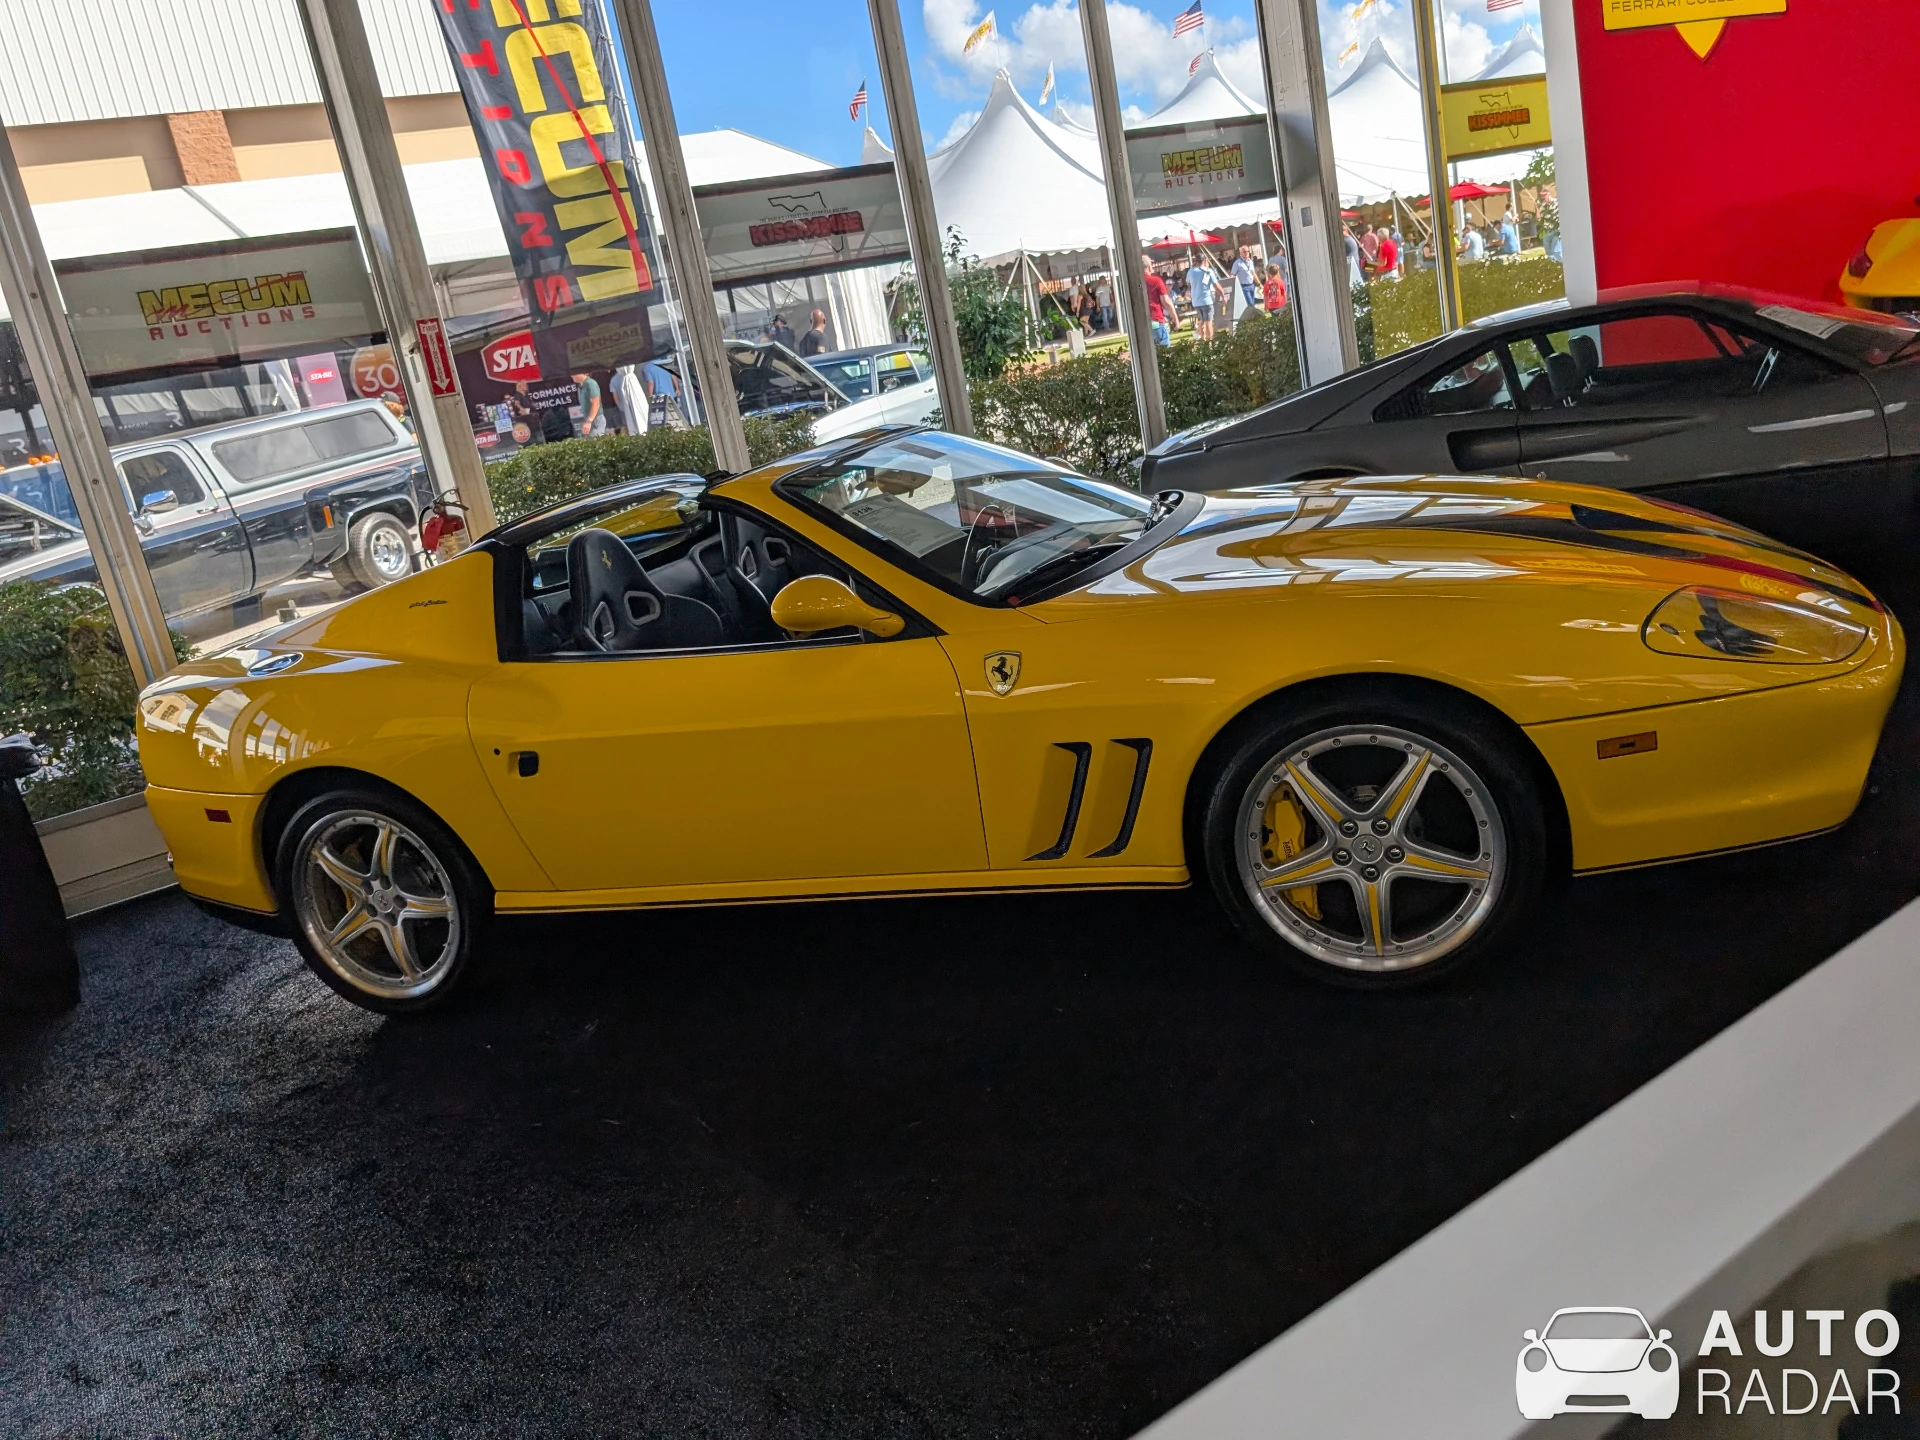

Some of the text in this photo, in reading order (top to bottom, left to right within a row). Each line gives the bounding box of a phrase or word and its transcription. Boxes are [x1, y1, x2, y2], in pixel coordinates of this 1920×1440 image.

[1611, 0, 1682, 13] FERRARI
[1468, 108, 1530, 132] KISSIMMEE
[443, 0, 574, 312] TIONS
[1161, 144, 1243, 178] MECUM
[1165, 169, 1245, 188] AUCTIONS
[749, 211, 864, 247] KISSIMMEE
[137, 271, 312, 326] MECUM
[149, 305, 316, 341] AUCTIONS
